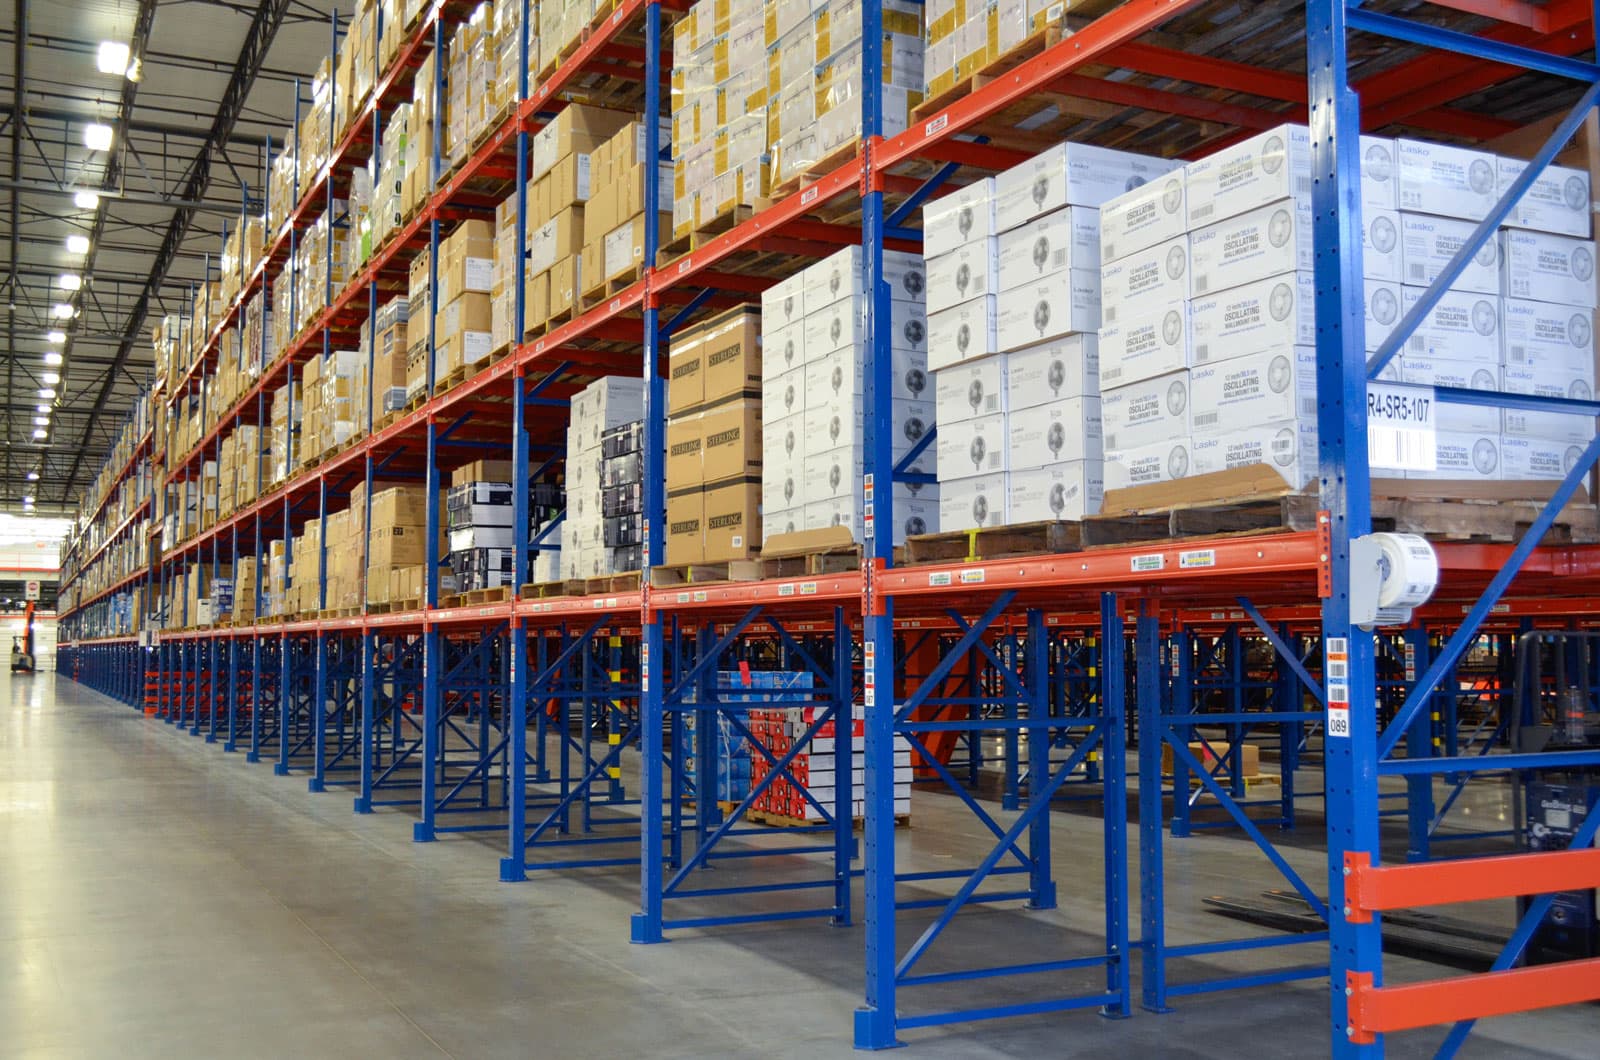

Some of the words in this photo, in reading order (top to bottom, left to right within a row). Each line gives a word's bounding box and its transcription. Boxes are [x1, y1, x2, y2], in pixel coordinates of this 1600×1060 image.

[1400, 144, 1430, 156] Lasko
[1405, 220, 1434, 232] Lasko
[1192, 231, 1216, 244] Lasko
[1224, 233, 1259, 252] OSCILLATING
[1510, 234, 1536, 245] Lasko
[1538, 255, 1568, 266] OSCILLATING
[1128, 267, 1159, 284] OSCILLATING
[1193, 302, 1216, 314] Lasko
[1224, 306, 1260, 322] OSCILLATING
[1507, 304, 1534, 315] Lasko
[1436, 312, 1468, 322] OSCILLATING
[1535, 324, 1566, 334] OSCILLATING
[1126, 331, 1156, 347] OSCILLATING
[709, 343, 740, 368] STERLING
[1403, 360, 1432, 370] Lasko
[1192, 368, 1215, 380] Lasko
[1506, 368, 1533, 379] Lasko
[1224, 376, 1259, 392] OSCILLATING
[1128, 400, 1160, 414] OSCILLATING
[1368, 392, 1430, 422] R4-SR5-107
[707, 428, 740, 448] STERLING
[1502, 437, 1528, 448] Lasko
[671, 438, 701, 456] STERLING
[1194, 440, 1218, 450] Lasko
[1226, 448, 1262, 462] OSCILLATING
[1436, 452, 1468, 460] OSCILLATING
[1530, 456, 1560, 466] OSCILLATING
[1130, 464, 1160, 475] OSCILLATING
[671, 520, 699, 534] STERLING
[709, 512, 742, 530] STERLING
[1330, 720, 1346, 732] 089
